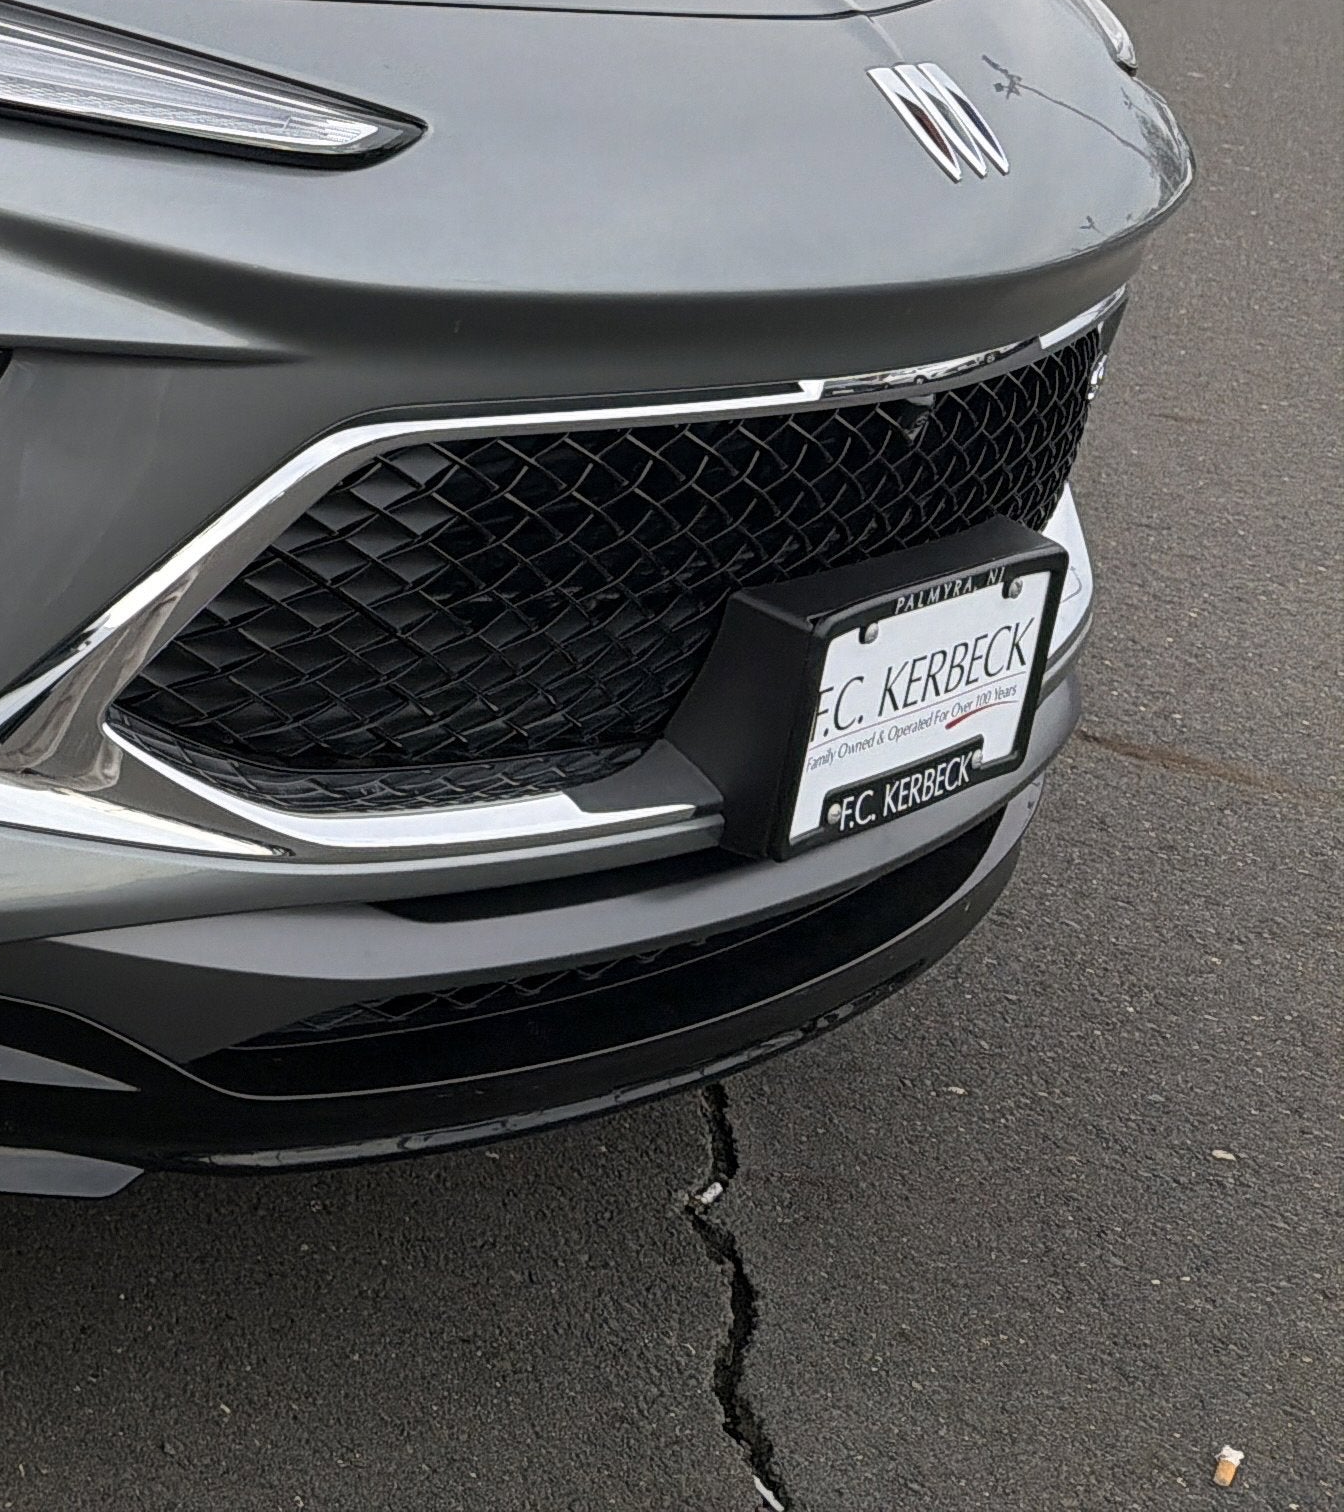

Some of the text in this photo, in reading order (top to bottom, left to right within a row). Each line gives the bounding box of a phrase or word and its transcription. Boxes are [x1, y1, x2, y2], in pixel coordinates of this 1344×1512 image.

[876, 616, 1036, 718] KERBECK
[806, 684, 1018, 773] Family Owned & Operated For Over 100 Years
[839, 751, 973, 832] F.C. KERBECK
